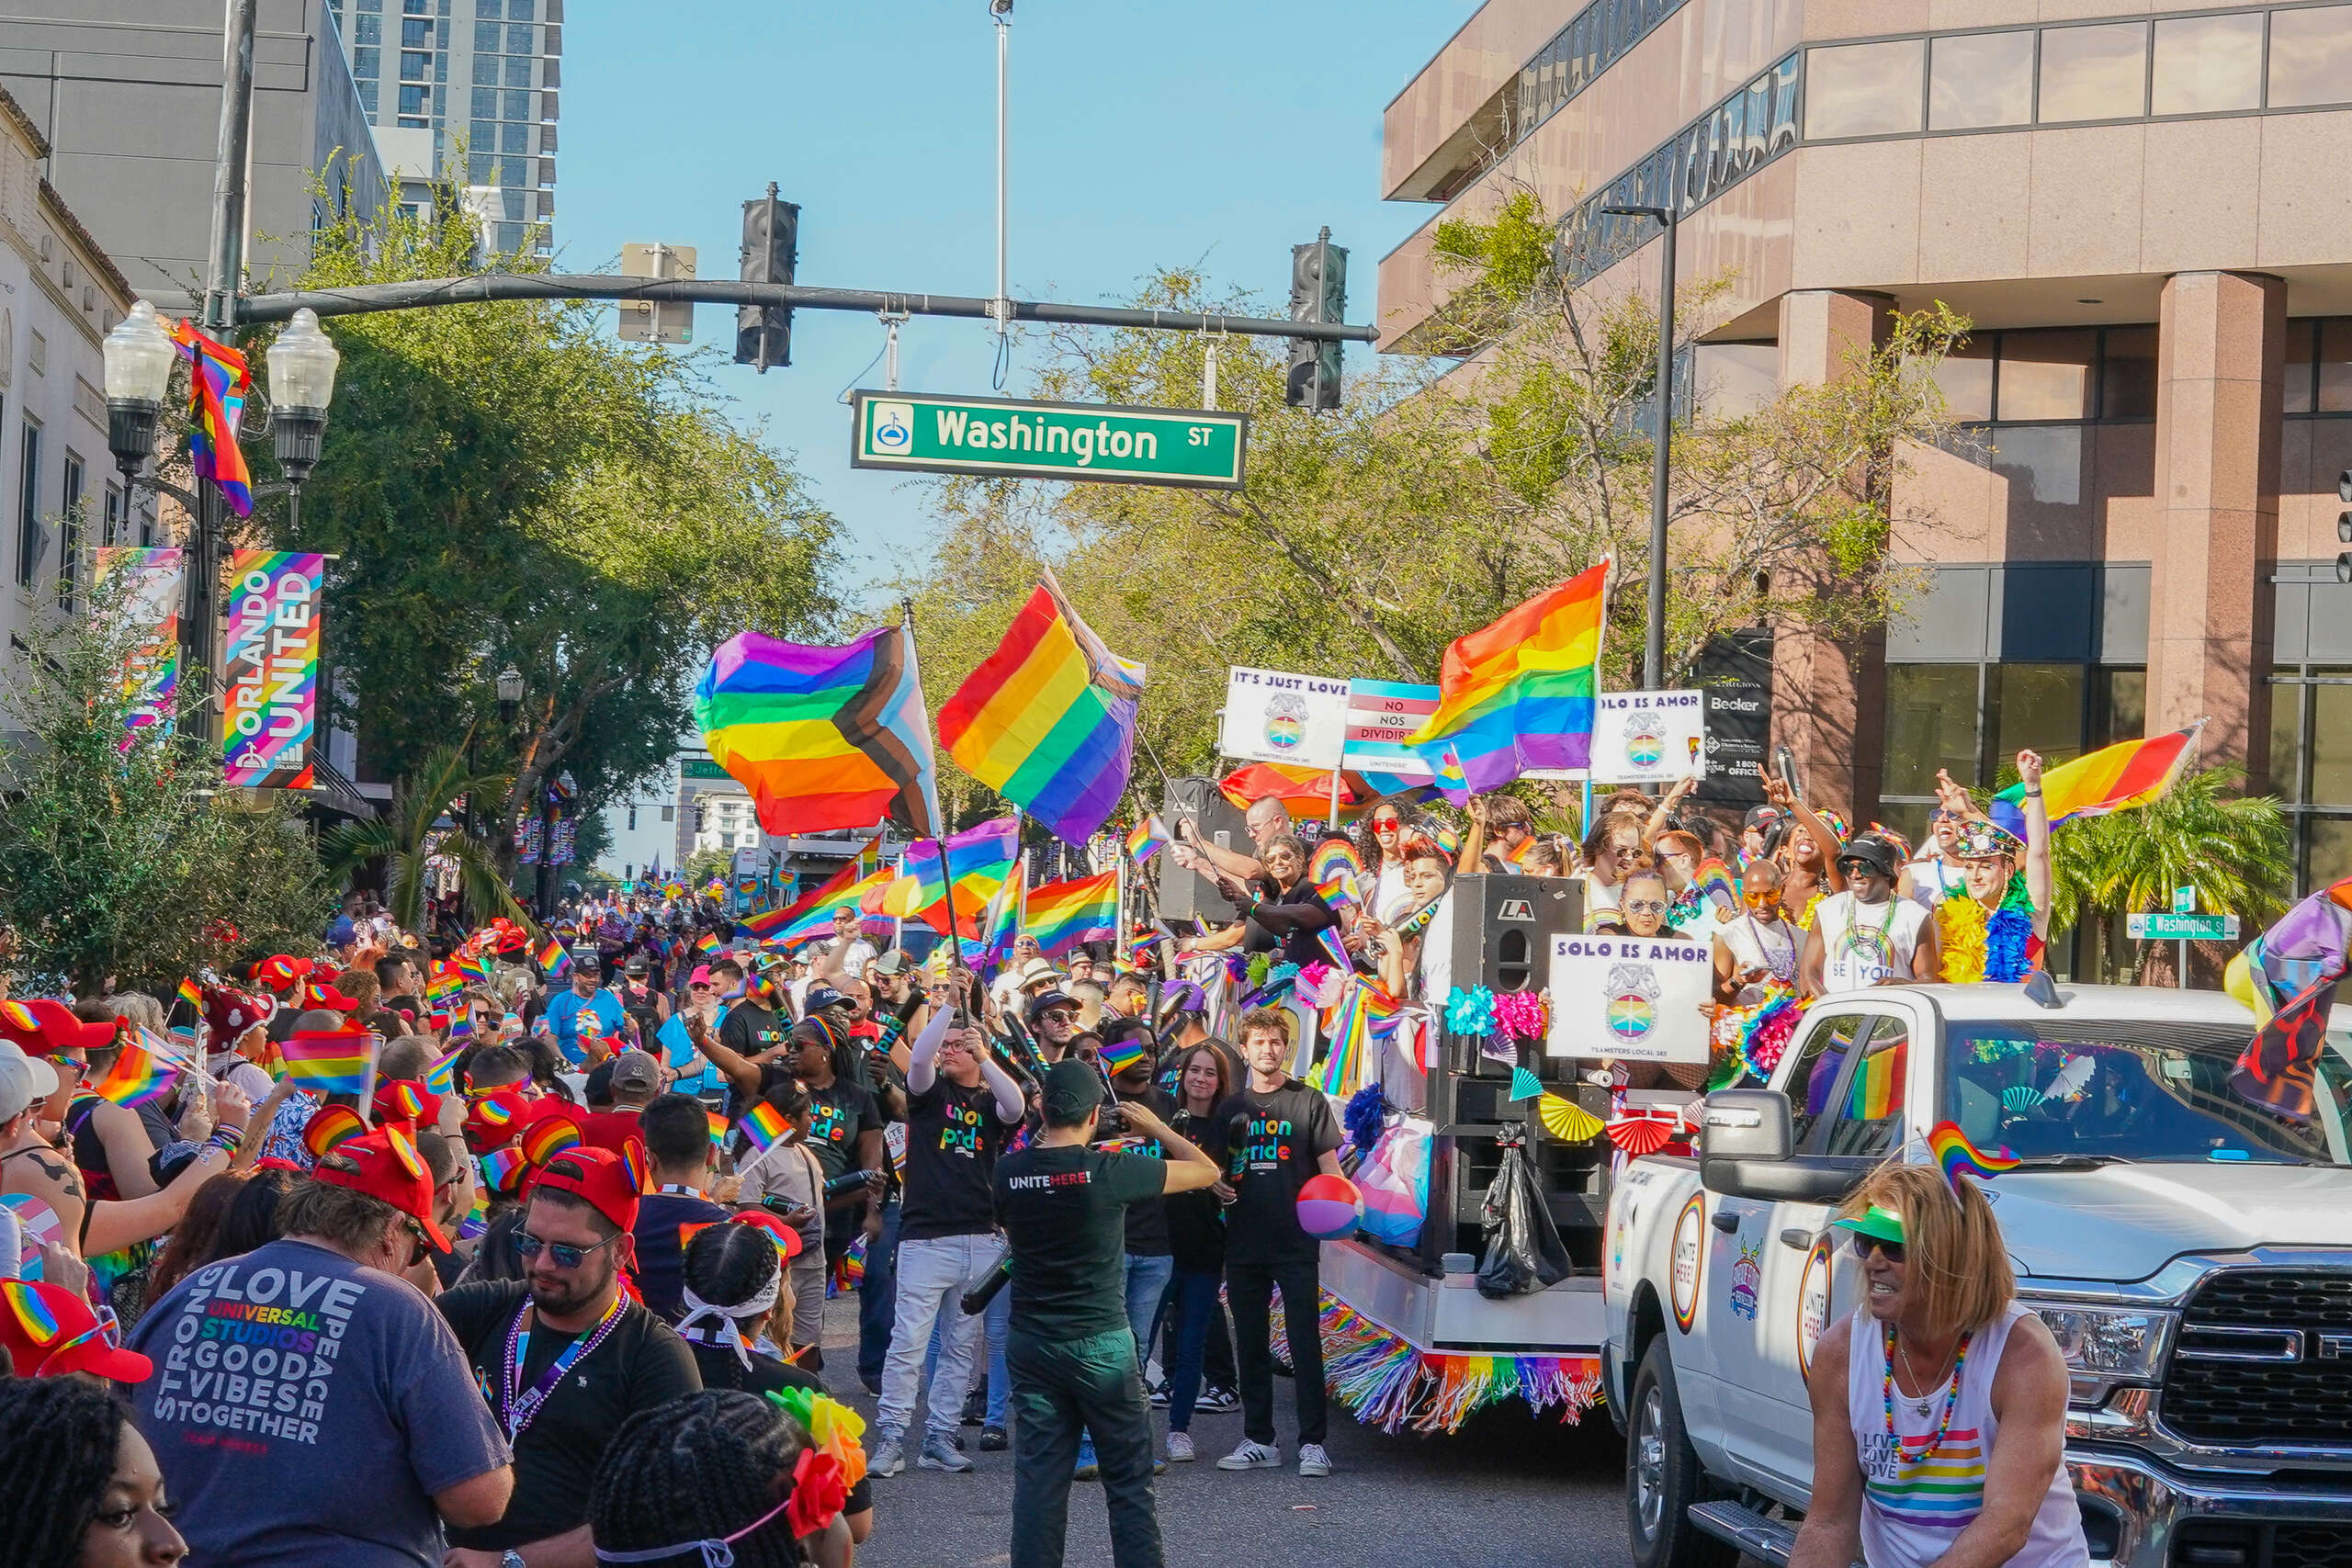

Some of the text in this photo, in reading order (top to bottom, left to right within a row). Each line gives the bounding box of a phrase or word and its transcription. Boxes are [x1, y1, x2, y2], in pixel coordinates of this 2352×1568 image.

[936, 410, 1214, 467] Washington ST
[235, 570, 270, 736] ORLANDO
[268, 572, 311, 738] UNITED
[1235, 671, 1347, 696] IT'S JUST LOVE
[1385, 702, 1404, 711] NO
[1602, 696, 1698, 709] LO ES AMOR
[1711, 697, 1759, 712] Becker
[1380, 716, 1405, 726] NOS
[1361, 729, 1413, 740] DIVIDIR
[1501, 901, 1532, 919] LA
[2145, 916, 2223, 937] E Washington St
[1558, 942, 1708, 962] SOLO ES AMOR
[1591, 1046, 1631, 1055] TEAMSTERS
[888, 1125, 903, 1140] ITE
[1247, 1111, 1293, 1137] nion
[1244, 1136, 1291, 1161] ride
[1009, 1170, 1091, 1190] UNITEHERE!
[1677, 1240, 1697, 1262] UNITE
[215, 1266, 367, 1320] LOVE
[1806, 1290, 1825, 1316] UNITE
[209, 1301, 321, 1331] UNIVERSAL
[154, 1267, 222, 1421] STRONG
[200, 1317, 317, 1353] STUDIOS
[195, 1341, 307, 1381] GOOD
[300, 1317, 347, 1421] PEACE
[189, 1369, 300, 1413] VIBES
[178, 1401, 320, 1445] TOGETHER
[1864, 1461, 1897, 1480] OVE
